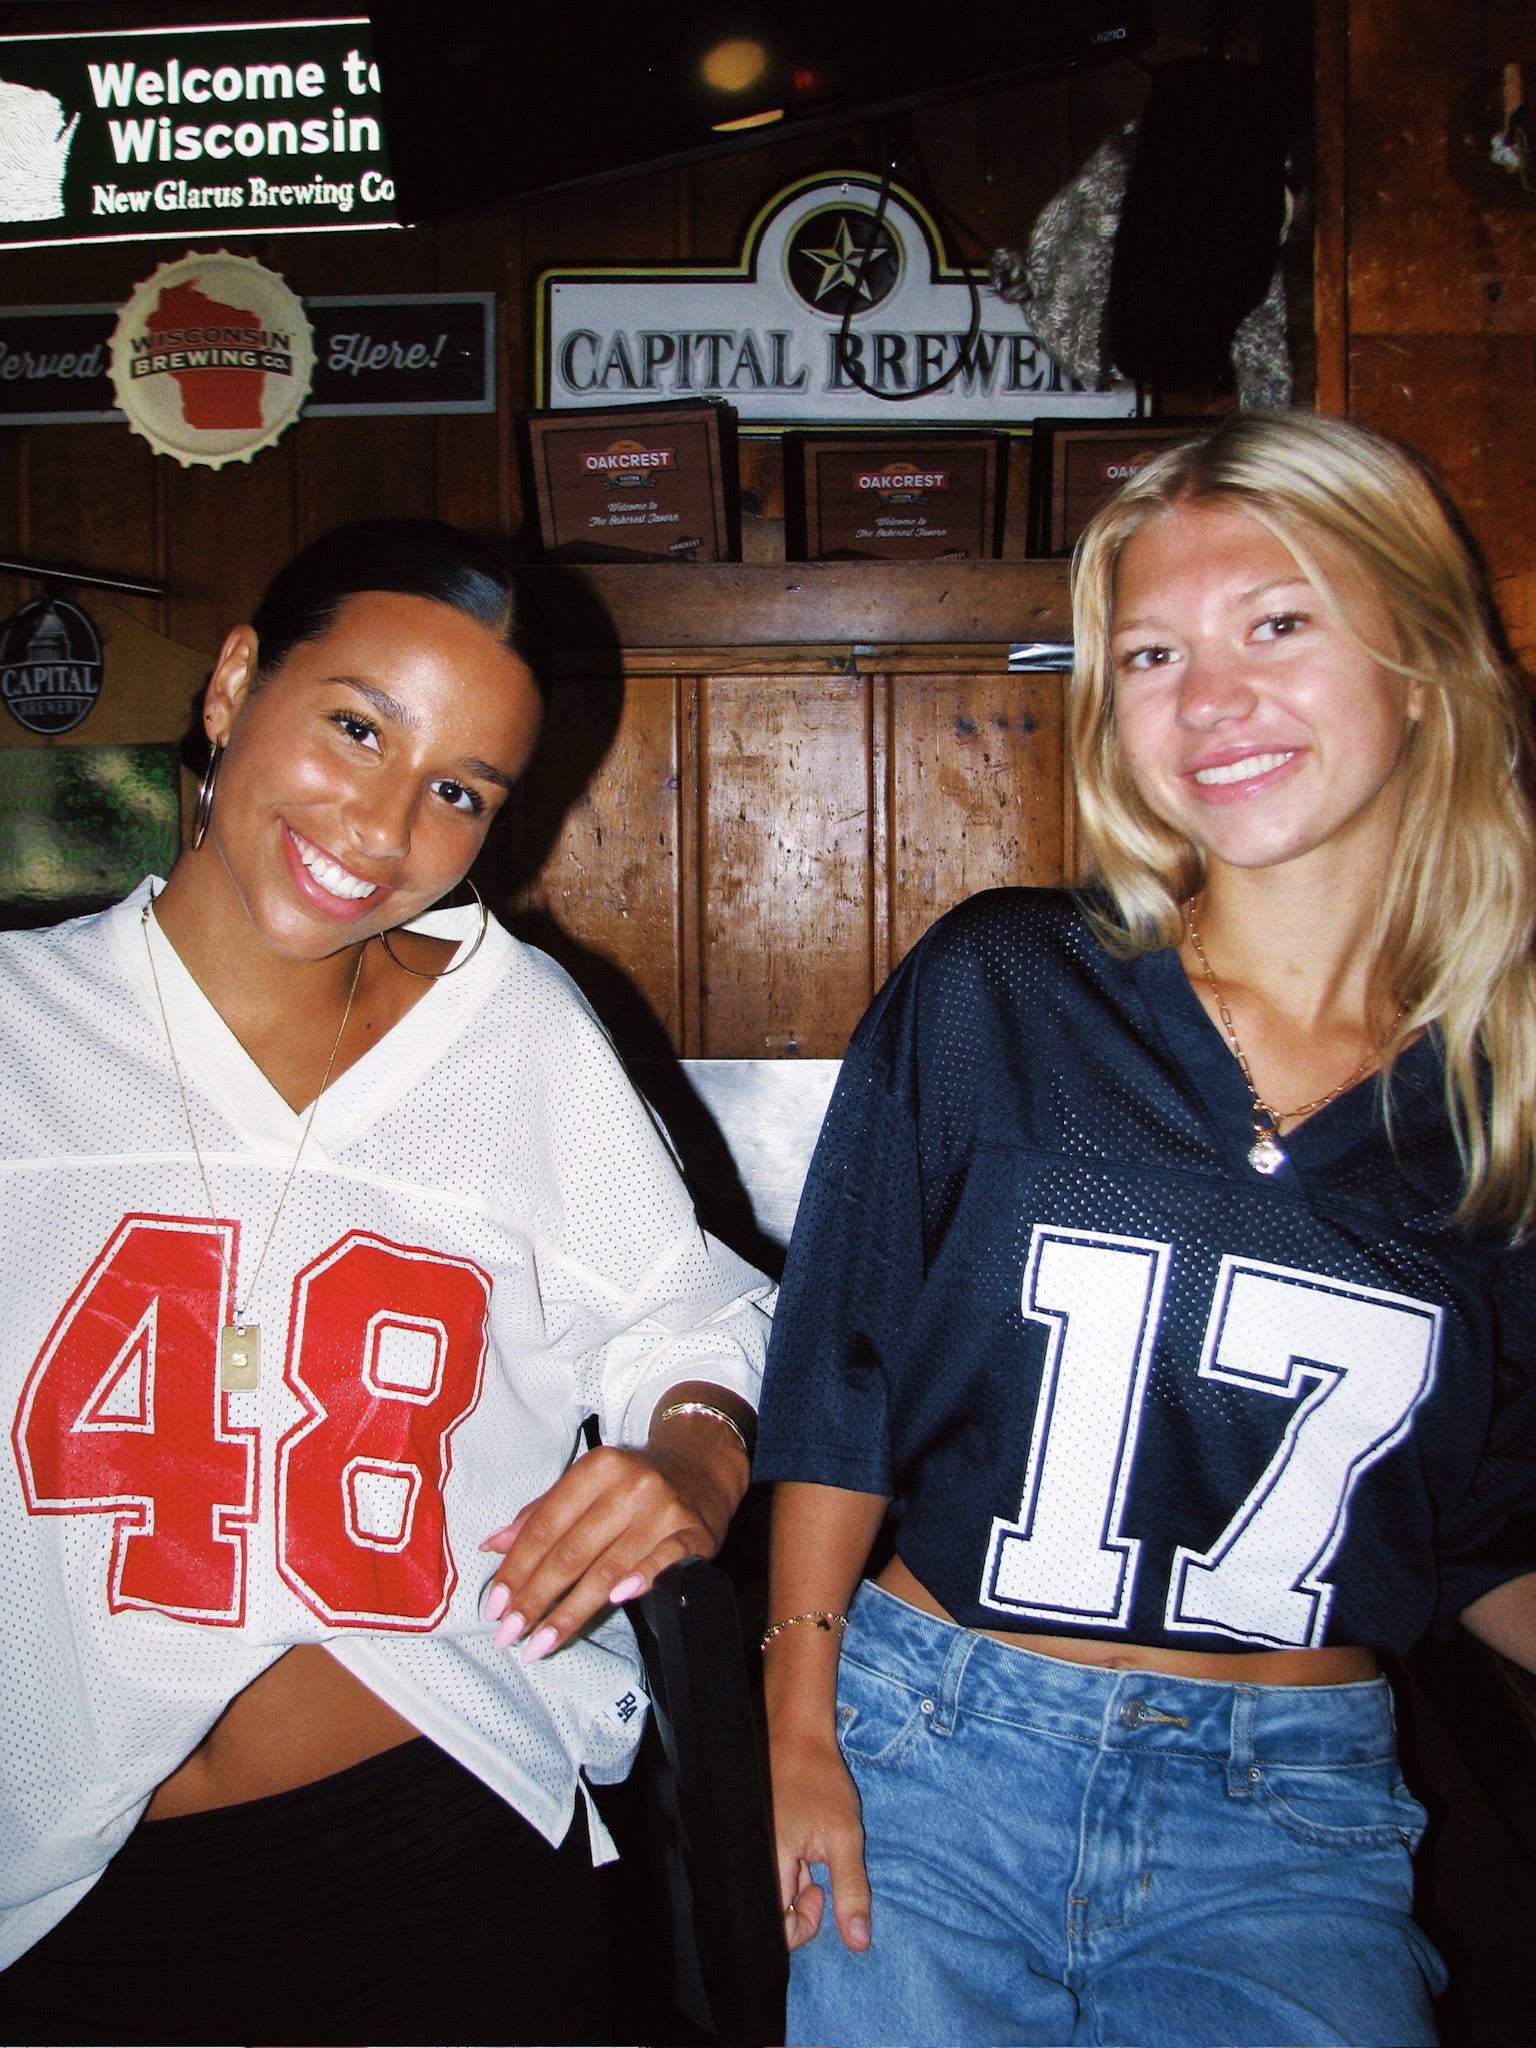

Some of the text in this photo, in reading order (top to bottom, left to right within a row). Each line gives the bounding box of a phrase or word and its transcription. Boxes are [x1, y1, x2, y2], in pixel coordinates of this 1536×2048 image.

[88, 57, 326, 109] Welcome
[108, 106, 381, 164] Wisconsin
[92, 183, 152, 215] New
[153, 177, 245, 211] Glarus
[247, 174, 355, 213] Brewing
[130, 325, 290, 353] WISCONSIN
[327, 332, 448, 377] Here!
[134, 349, 258, 376] BREWING
[559, 331, 1114, 394] CAPITAL BREWE
[586, 452, 670, 470] OAKCREST
[859, 475, 944, 489] OAKCREST
[589, 516, 607, 528] The
[609, 514, 647, 526] Oakcrest
[607, 501, 659, 513] Welcome to
[1, 665, 99, 698] CAPITAL
[11, 1212, 494, 1633] 48
[979, 1223, 1444, 1651] 17
